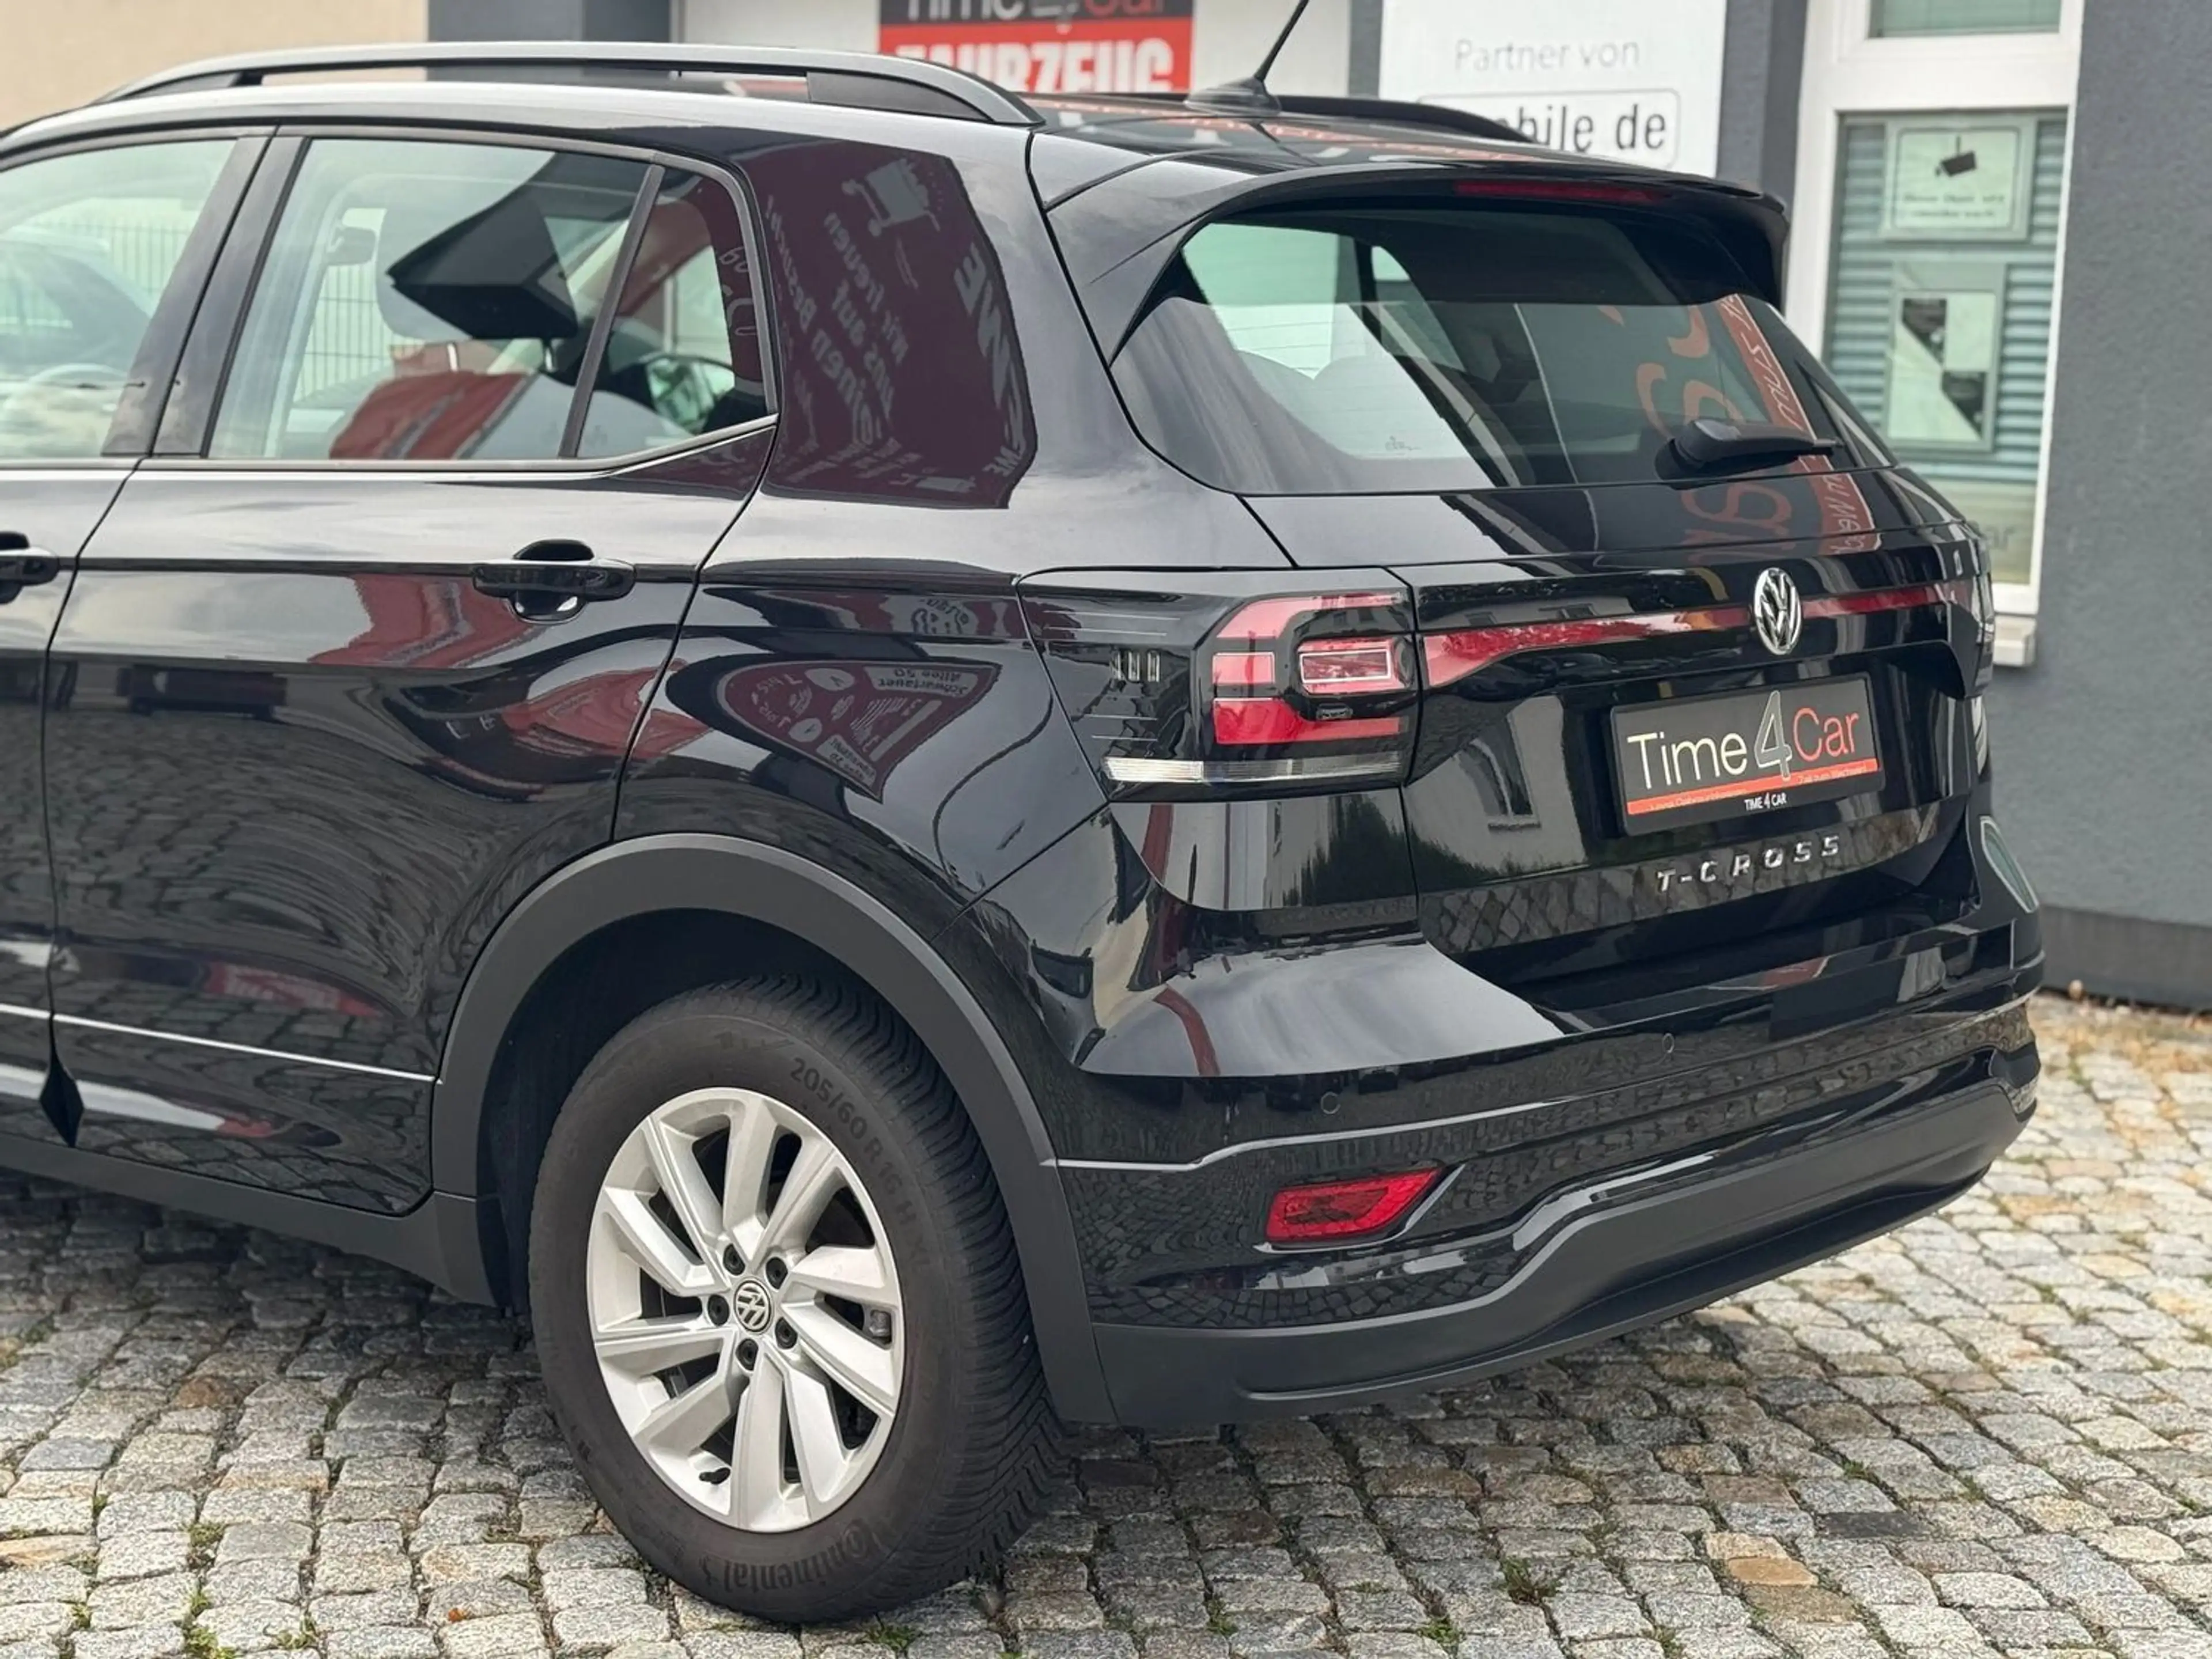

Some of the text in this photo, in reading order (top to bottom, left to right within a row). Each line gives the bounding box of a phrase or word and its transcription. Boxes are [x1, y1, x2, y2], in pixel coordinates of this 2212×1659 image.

[895, 37, 1174, 93] RZEUG
[1455, 38, 1641, 71] Partner von
[1497, 104, 1666, 153] bile de
[1657, 836, 1840, 892] T-CROSS
[790, 1057, 868, 1141] 205/60
